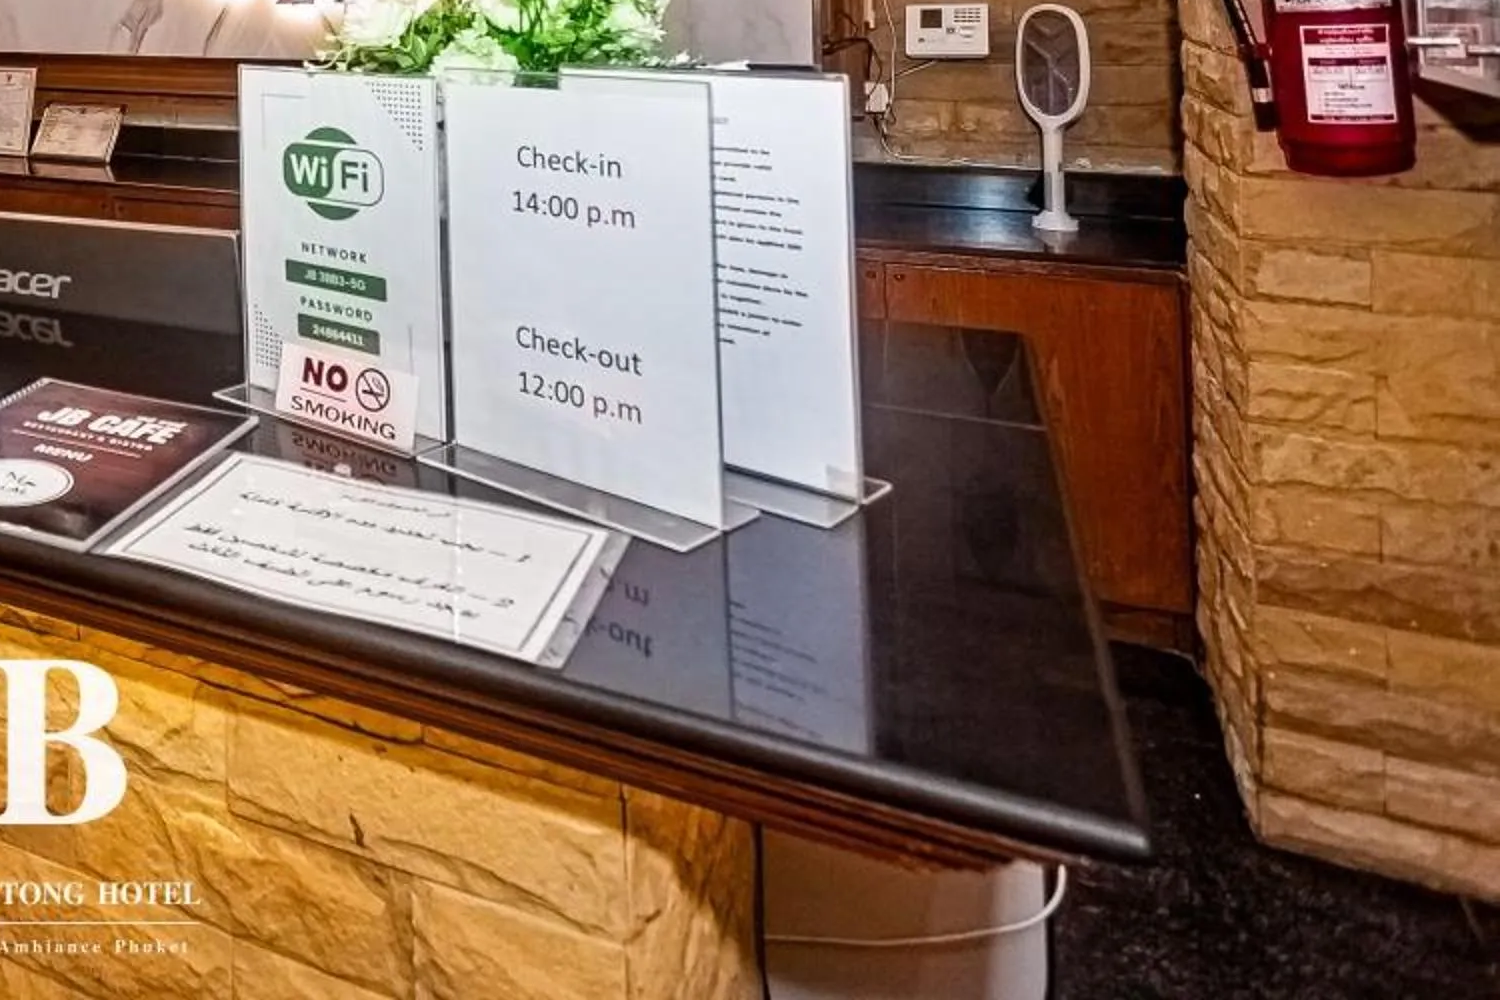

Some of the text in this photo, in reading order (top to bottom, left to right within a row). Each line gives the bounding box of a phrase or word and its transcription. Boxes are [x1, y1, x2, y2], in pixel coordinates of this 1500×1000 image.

[516, 144, 622, 179] Check-in
[512, 189, 636, 229] 14:00 p.m
[300, 241, 368, 264] NETWORK
[299, 295, 374, 323] PASSWORD
[515, 325, 643, 377] Check-out
[301, 356, 349, 393] NO
[36, 406, 92, 426] JB
[517, 371, 643, 425] 12:00 p.m
[290, 394, 397, 441] SMOKING
[32, 443, 94, 463] MENU
